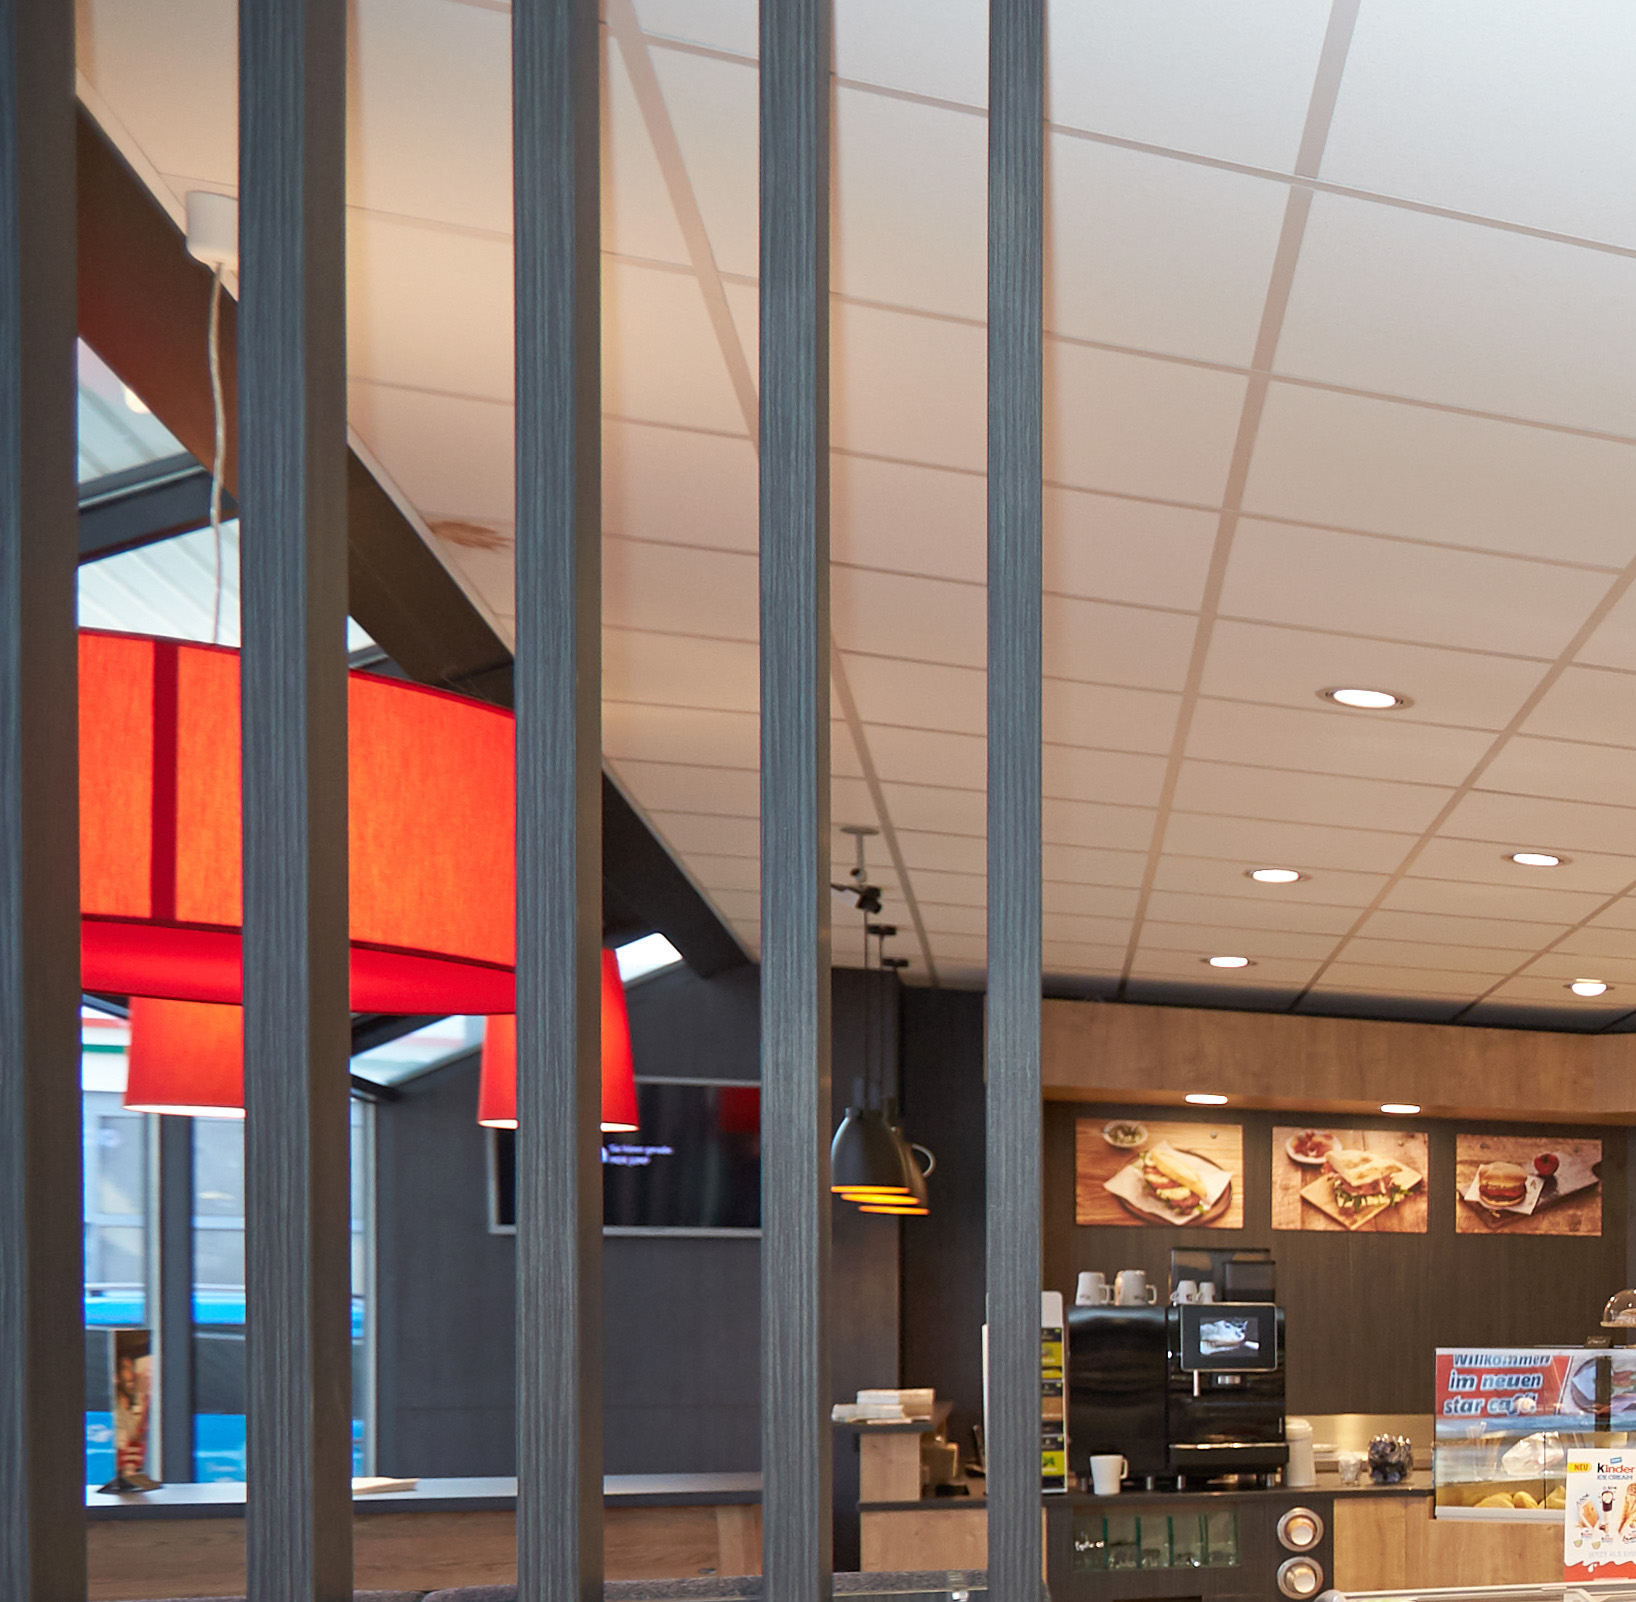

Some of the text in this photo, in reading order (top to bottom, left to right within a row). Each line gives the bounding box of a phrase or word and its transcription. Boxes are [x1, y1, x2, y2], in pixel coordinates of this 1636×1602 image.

[1450, 1370, 1543, 1391] im neuen
[1444, 1396, 1485, 1416] star
[1574, 1463, 1635, 1474] NEU kinder
